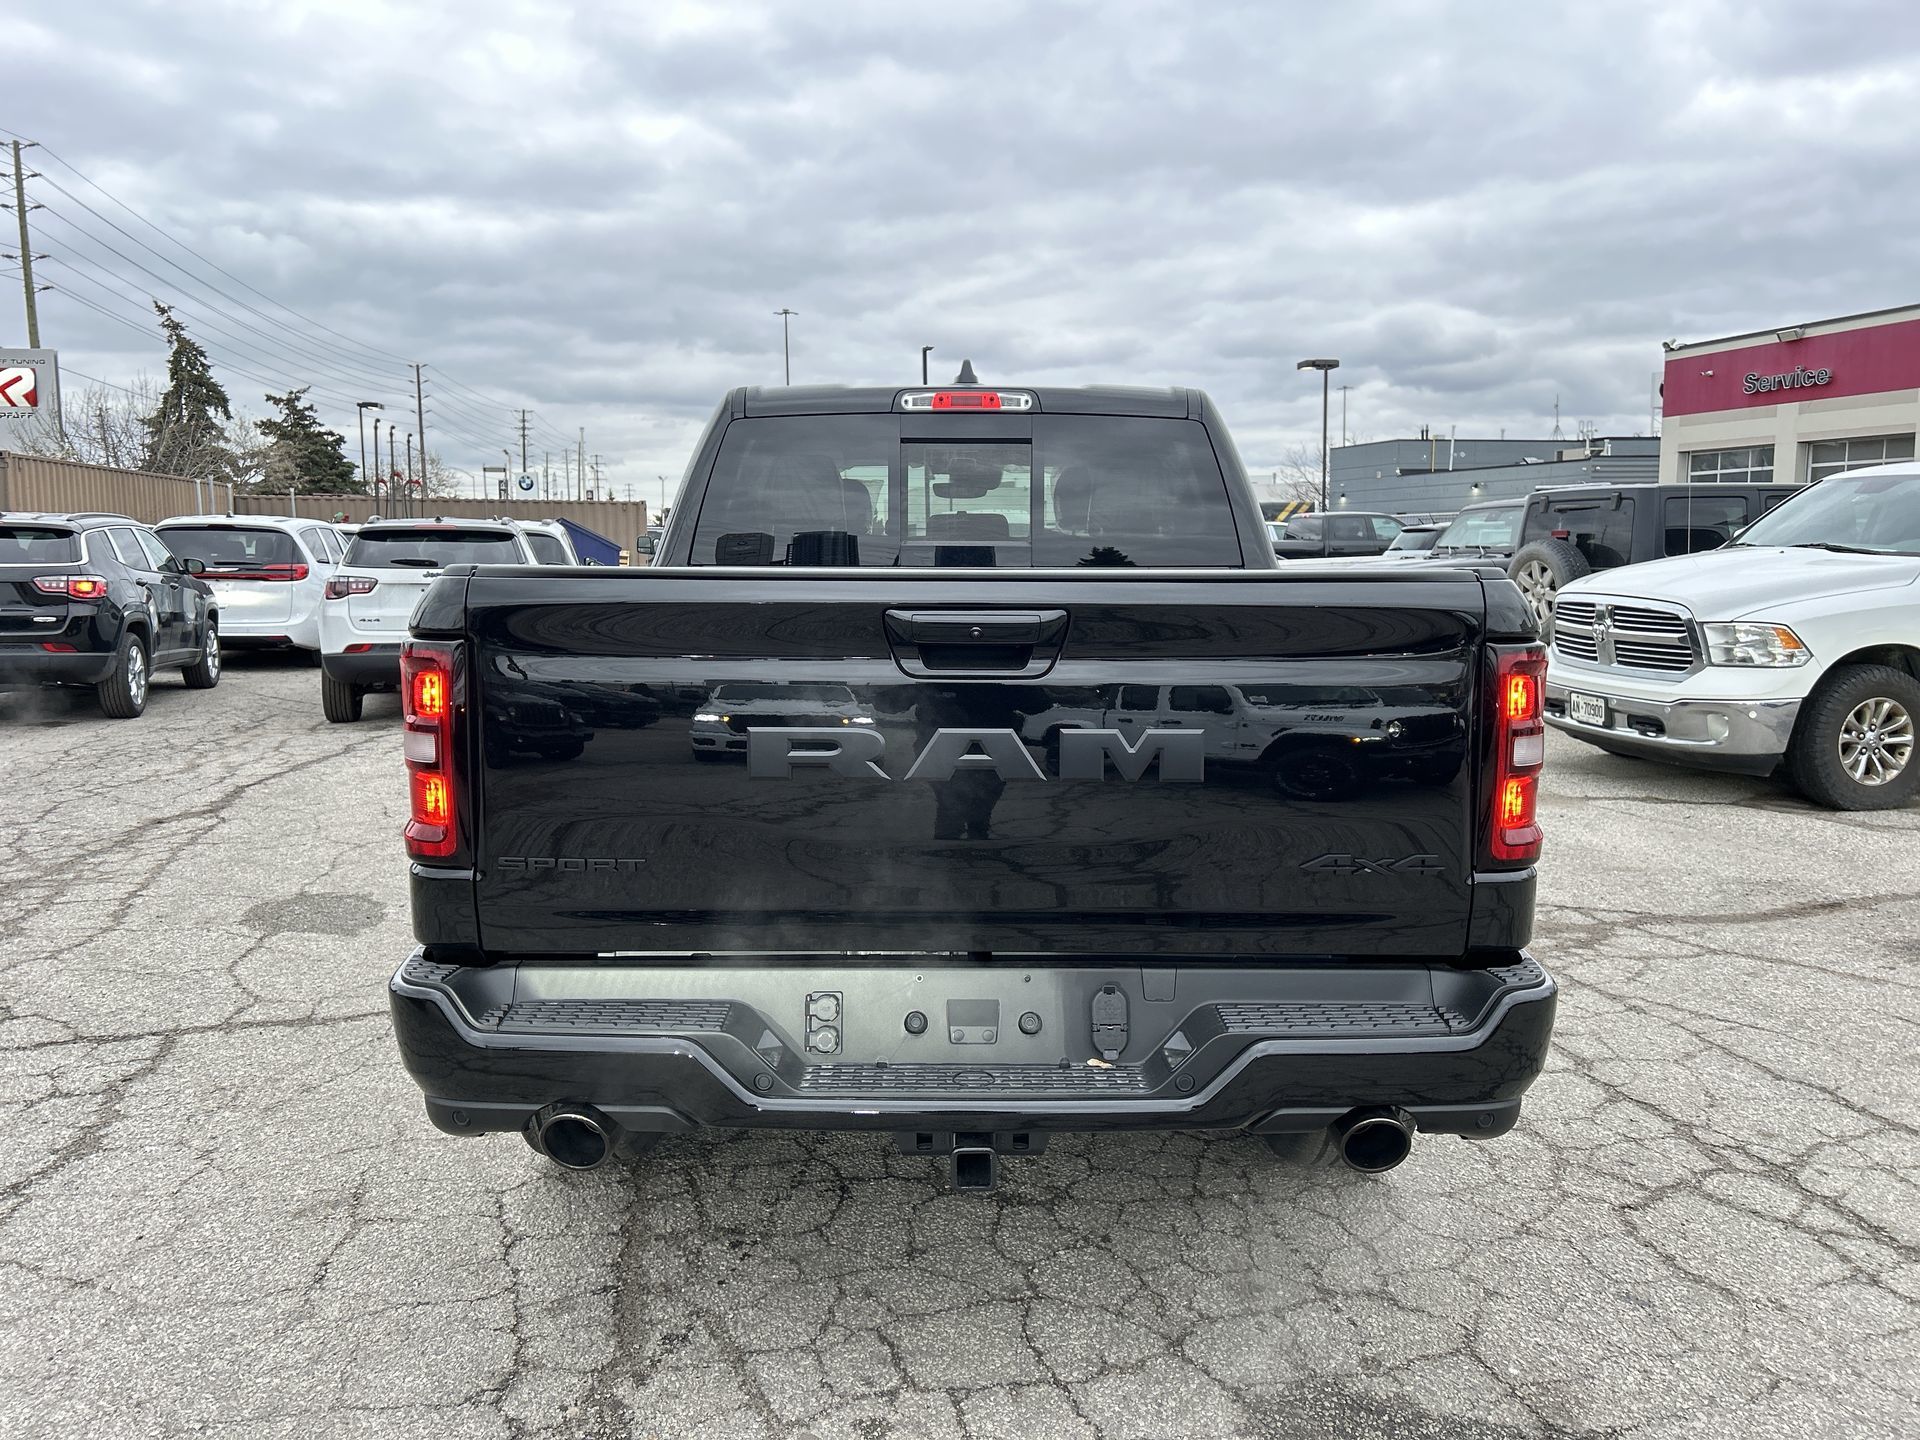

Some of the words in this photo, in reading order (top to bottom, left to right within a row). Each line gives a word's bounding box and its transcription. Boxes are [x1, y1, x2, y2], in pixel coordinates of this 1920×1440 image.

[1743, 365, 1831, 394] Service
[746, 726, 1205, 782] RAM
[498, 857, 646, 872] SPORT
